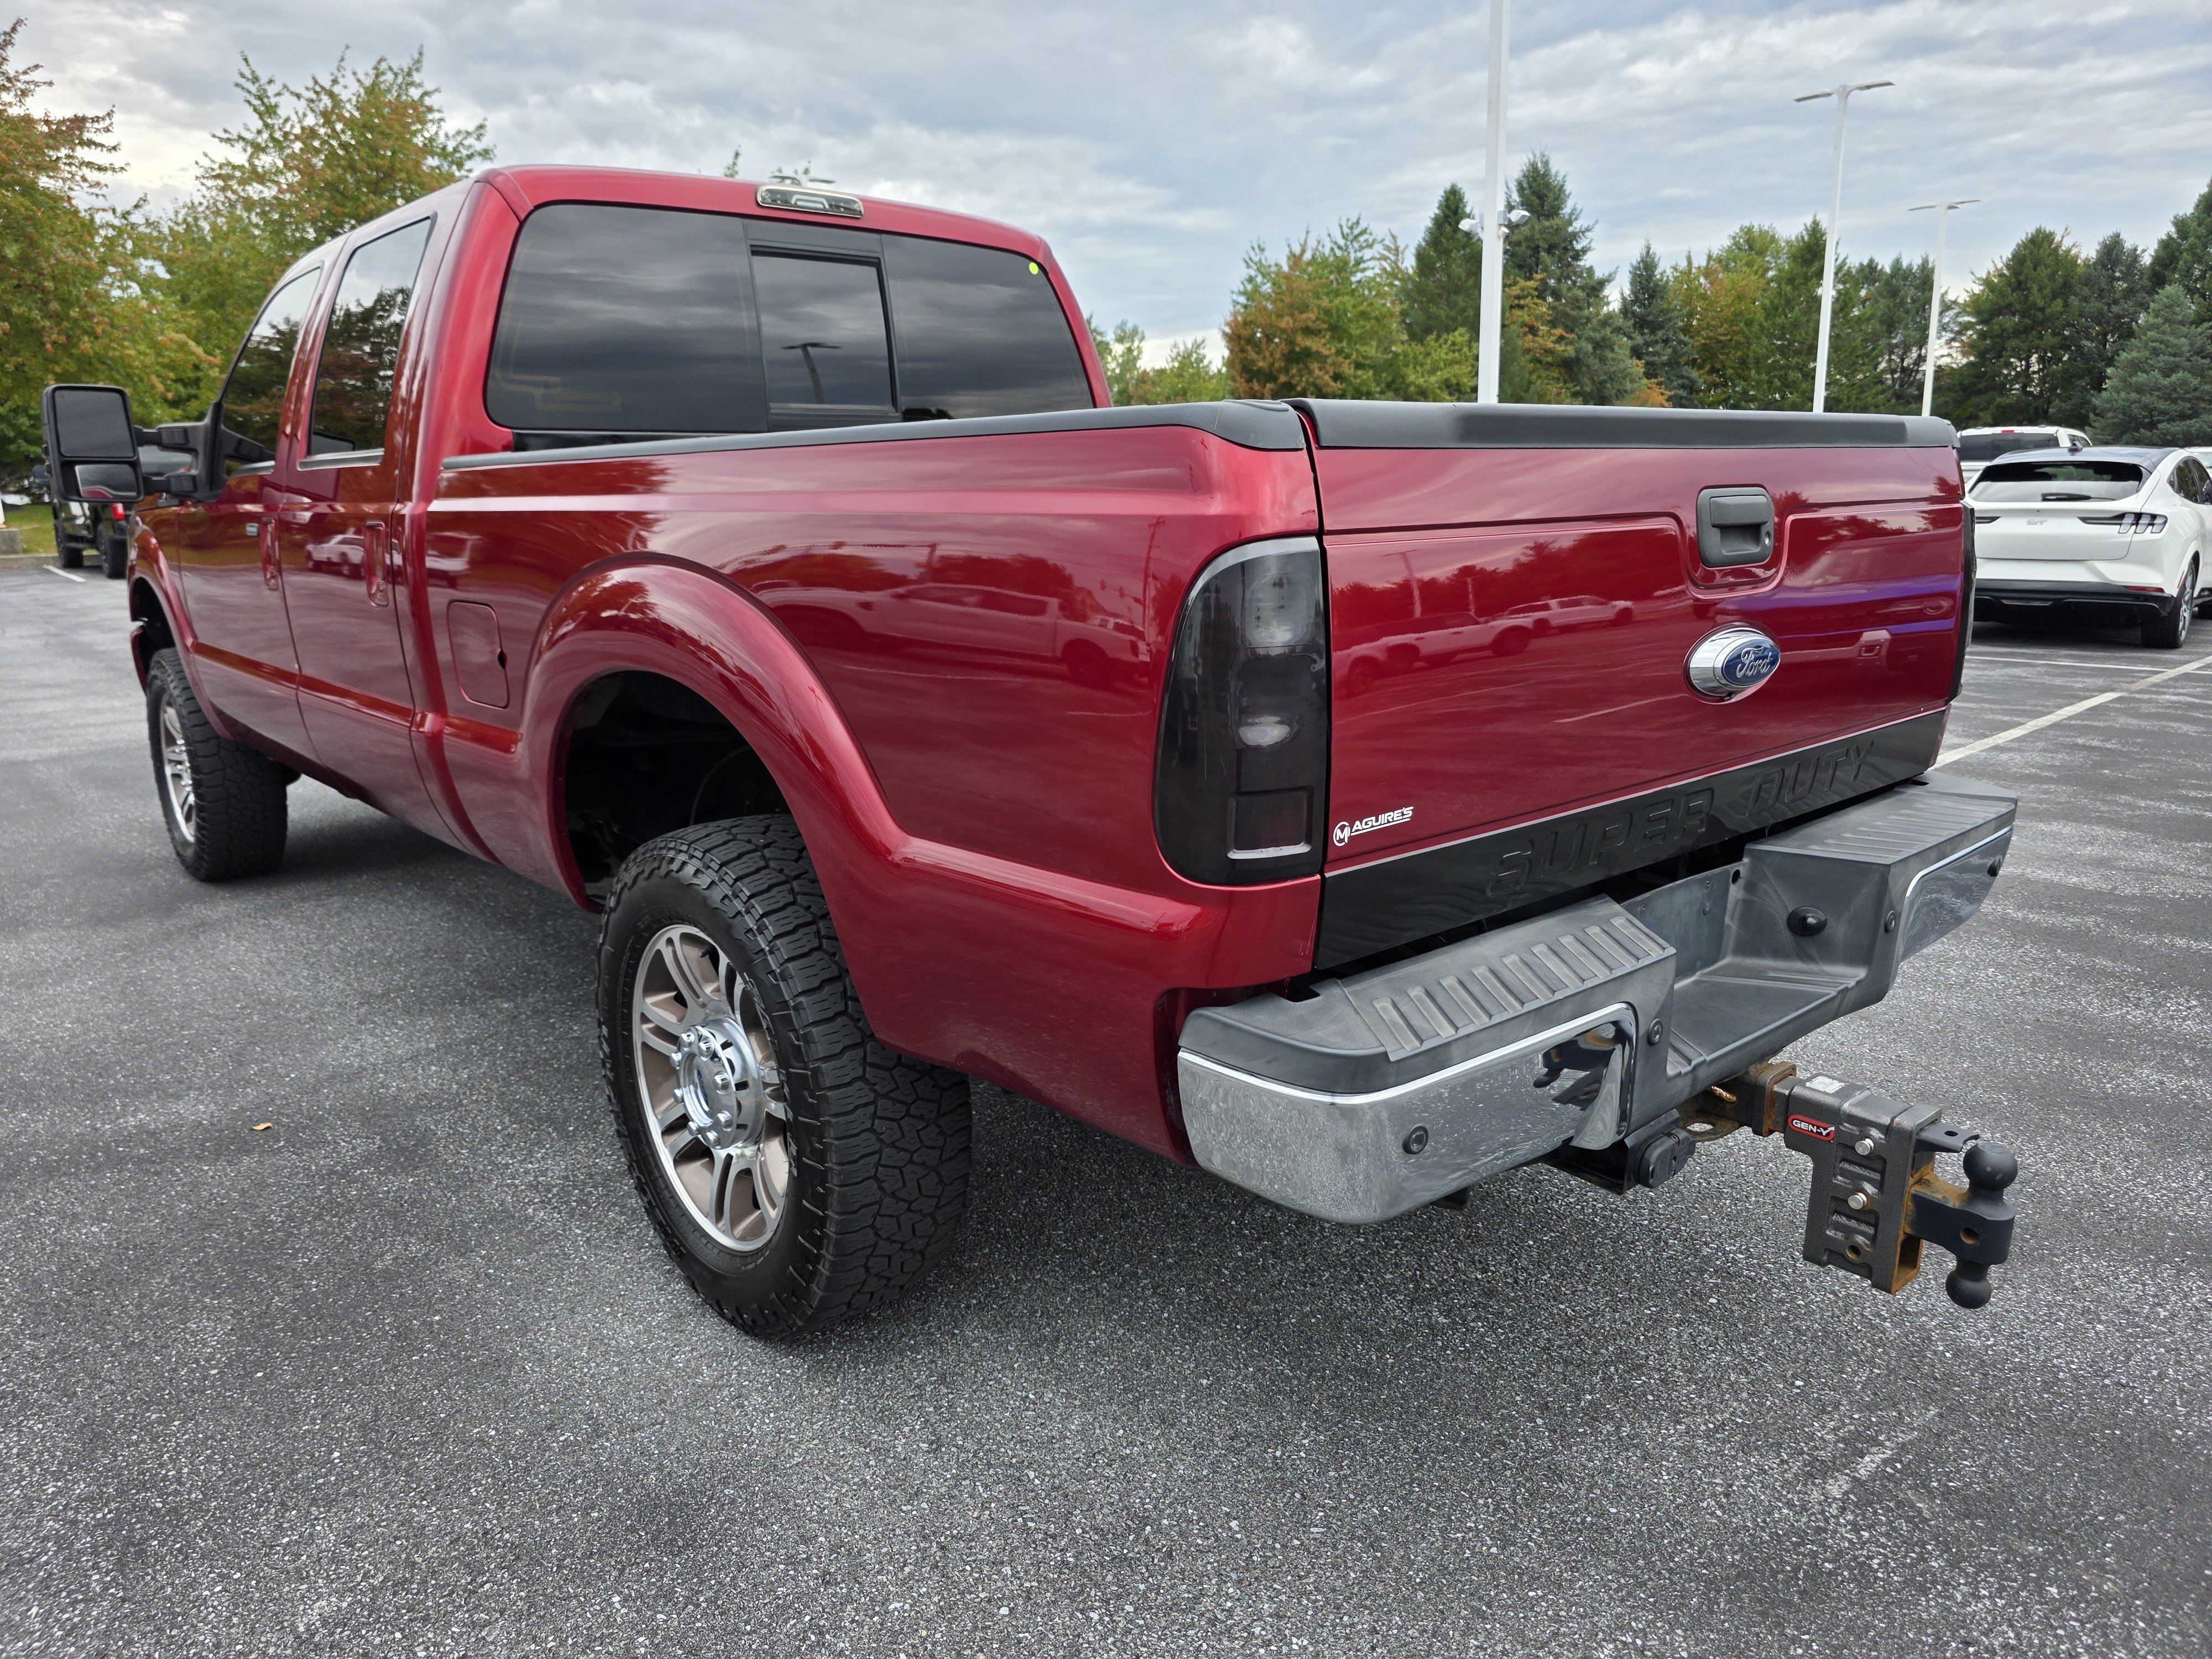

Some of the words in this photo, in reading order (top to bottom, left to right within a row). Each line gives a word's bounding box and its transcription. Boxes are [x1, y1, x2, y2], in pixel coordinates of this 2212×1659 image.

[1736, 646, 1773, 678] Ford
[1486, 787, 1715, 898] SUPER
[1746, 740, 1875, 817] DUTY
[1792, 1119, 1835, 1136] GEN-Y
